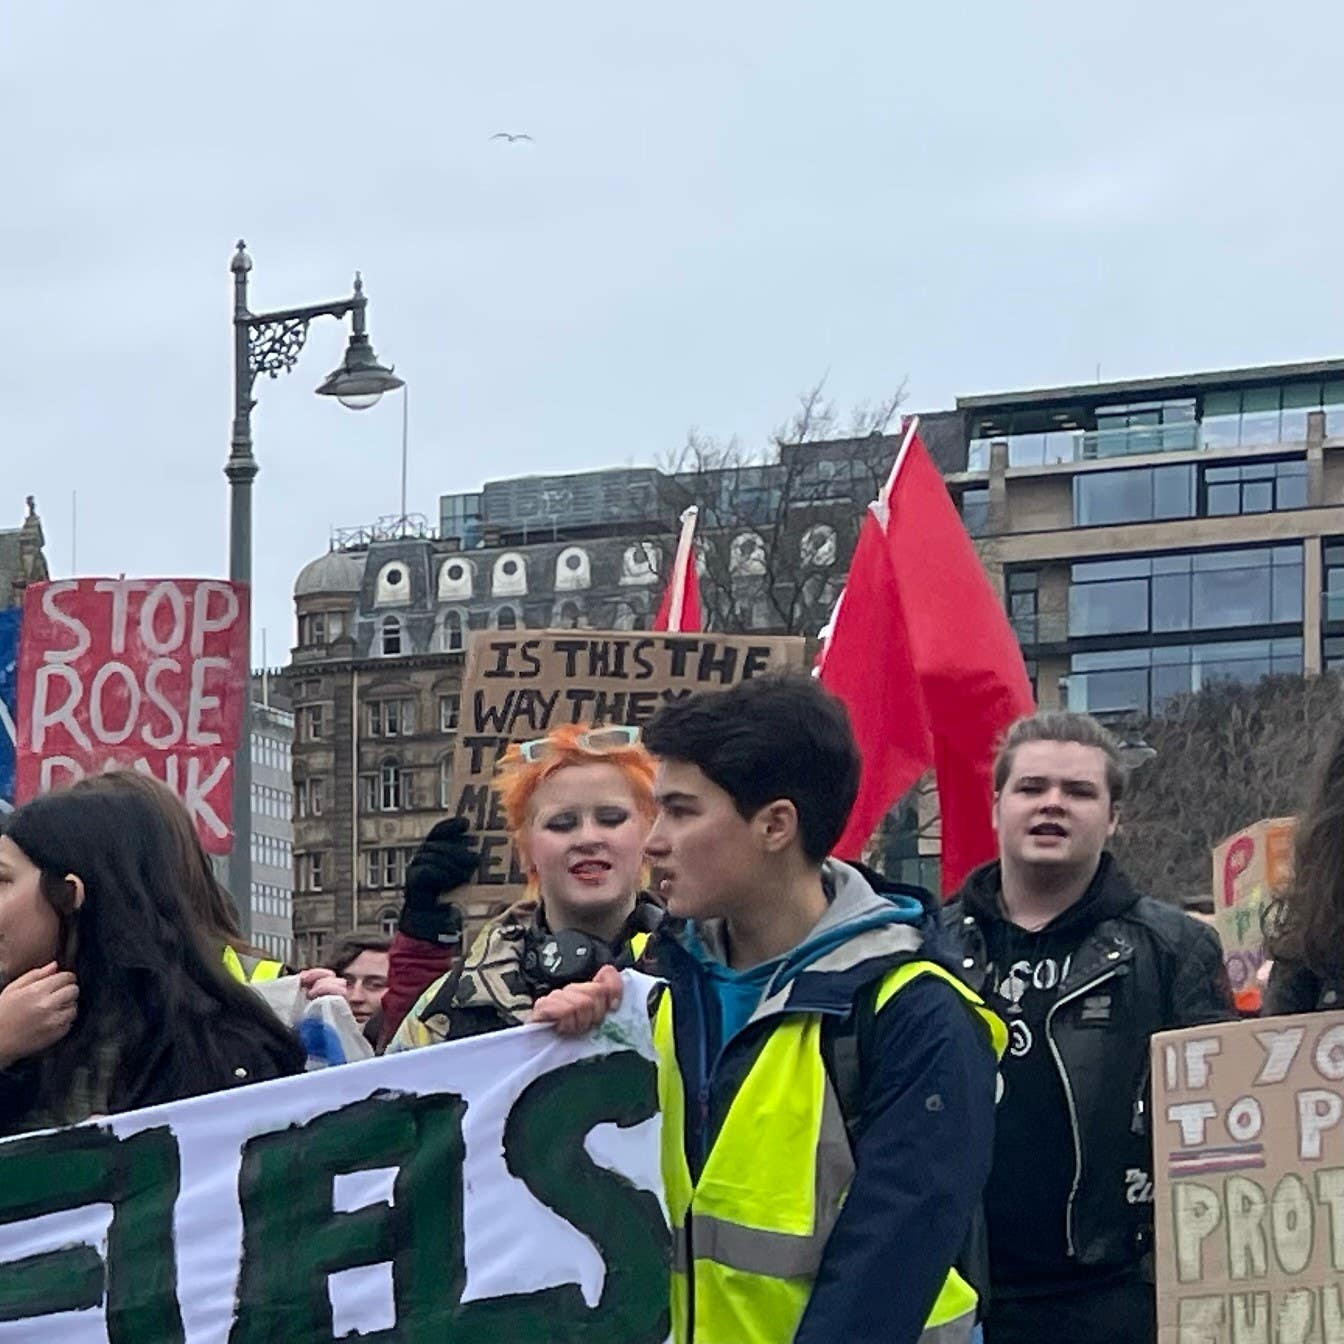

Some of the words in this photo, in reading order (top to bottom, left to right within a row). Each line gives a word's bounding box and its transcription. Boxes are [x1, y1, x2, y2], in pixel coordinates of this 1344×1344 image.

[41, 580, 240, 664] STOP
[484, 640, 542, 680] IS
[553, 640, 656, 680] THIS
[664, 638, 771, 685] THE
[30, 656, 232, 754] ROSE
[473, 689, 559, 734] WAY
[565, 688, 693, 730] THE
[1164, 1036, 1221, 1091] IF
[1165, 1095, 1264, 1148] TO
